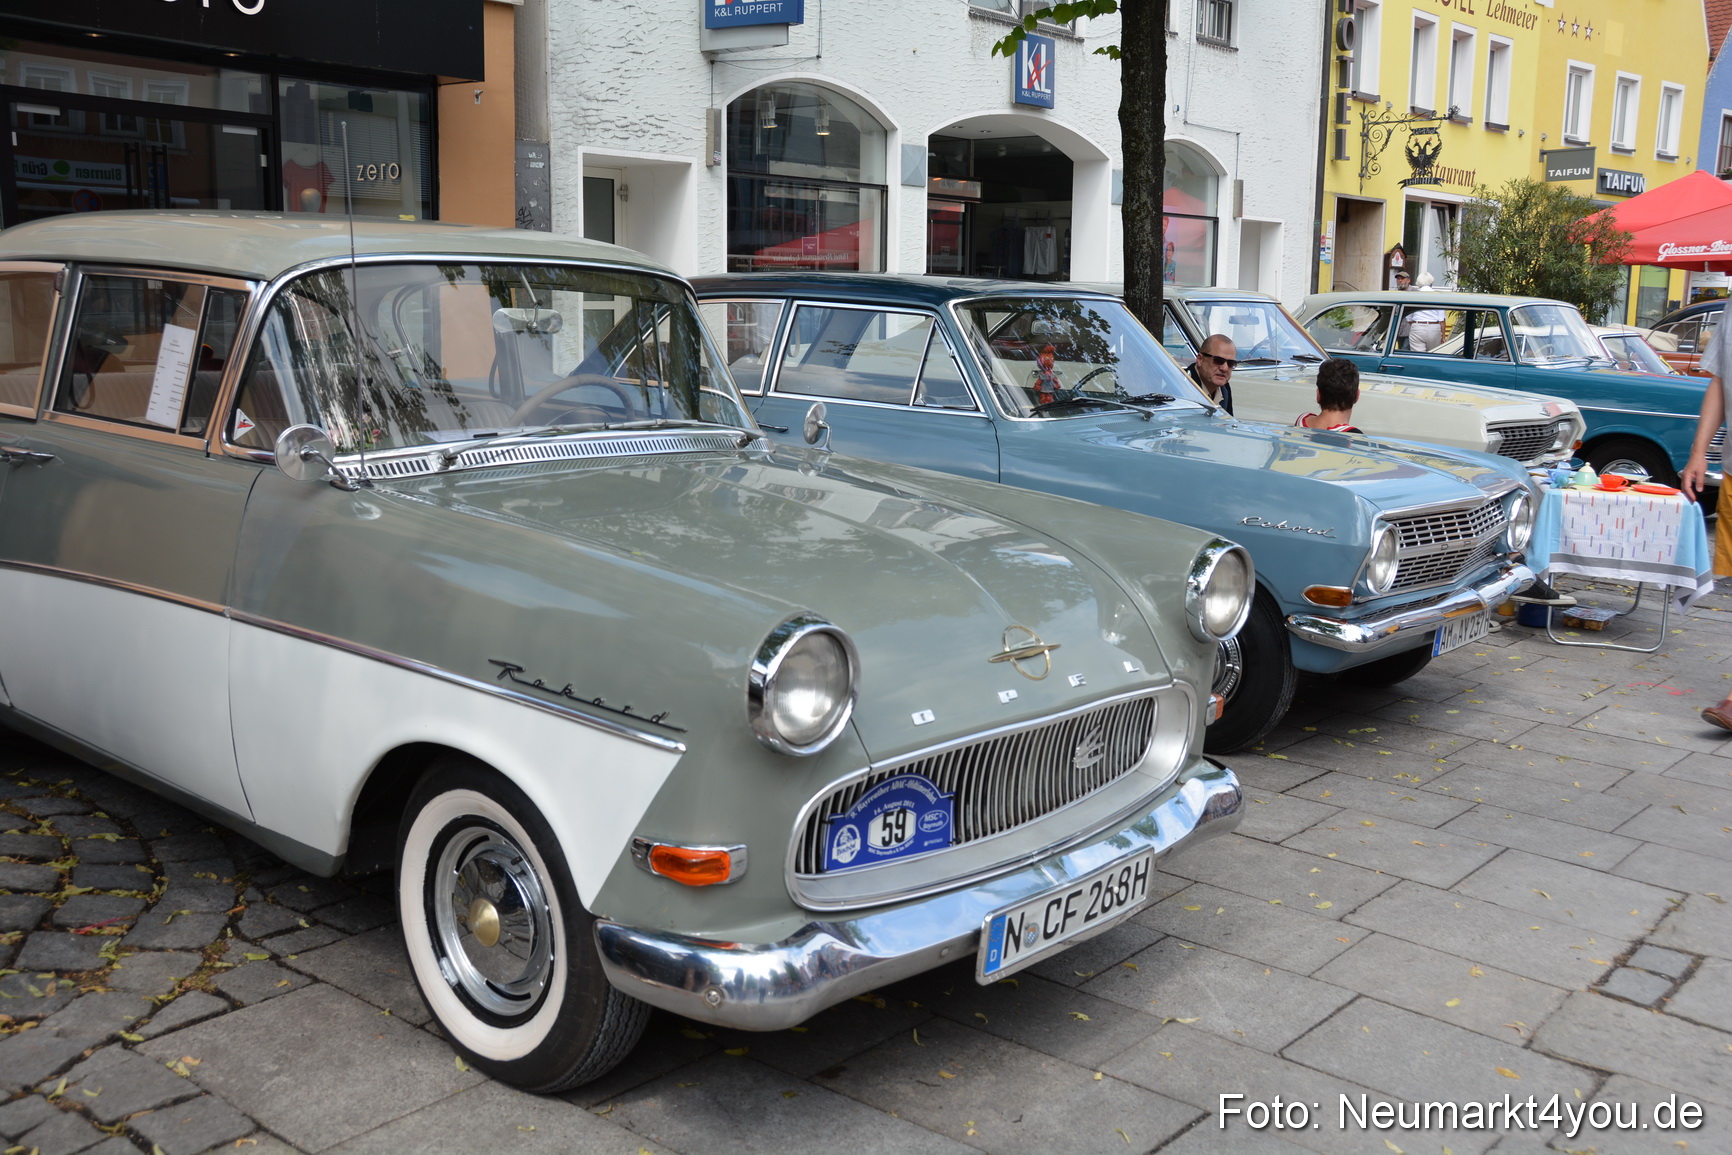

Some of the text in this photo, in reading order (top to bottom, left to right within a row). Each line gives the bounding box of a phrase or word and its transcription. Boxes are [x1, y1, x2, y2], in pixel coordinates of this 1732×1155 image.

[714, 7, 733, 18] K&L
[734, 2, 784, 15] RUPPERT
[1486, 0, 1538, 31] Lehmeier
[1031, 91, 1052, 101] RUPPERT
[356, 162, 400, 182] zero
[1547, 167, 1591, 177] TAIFUN
[1605, 171, 1647, 193] TAIFUN
[1237, 515, 1337, 539] Rekord
[882, 800, 903, 812] August
[924, 812, 939, 822] MSC
[881, 807, 908, 847] 59
[1003, 857, 1150, 960] N CF 268H
[989, 948, 998, 962] D
